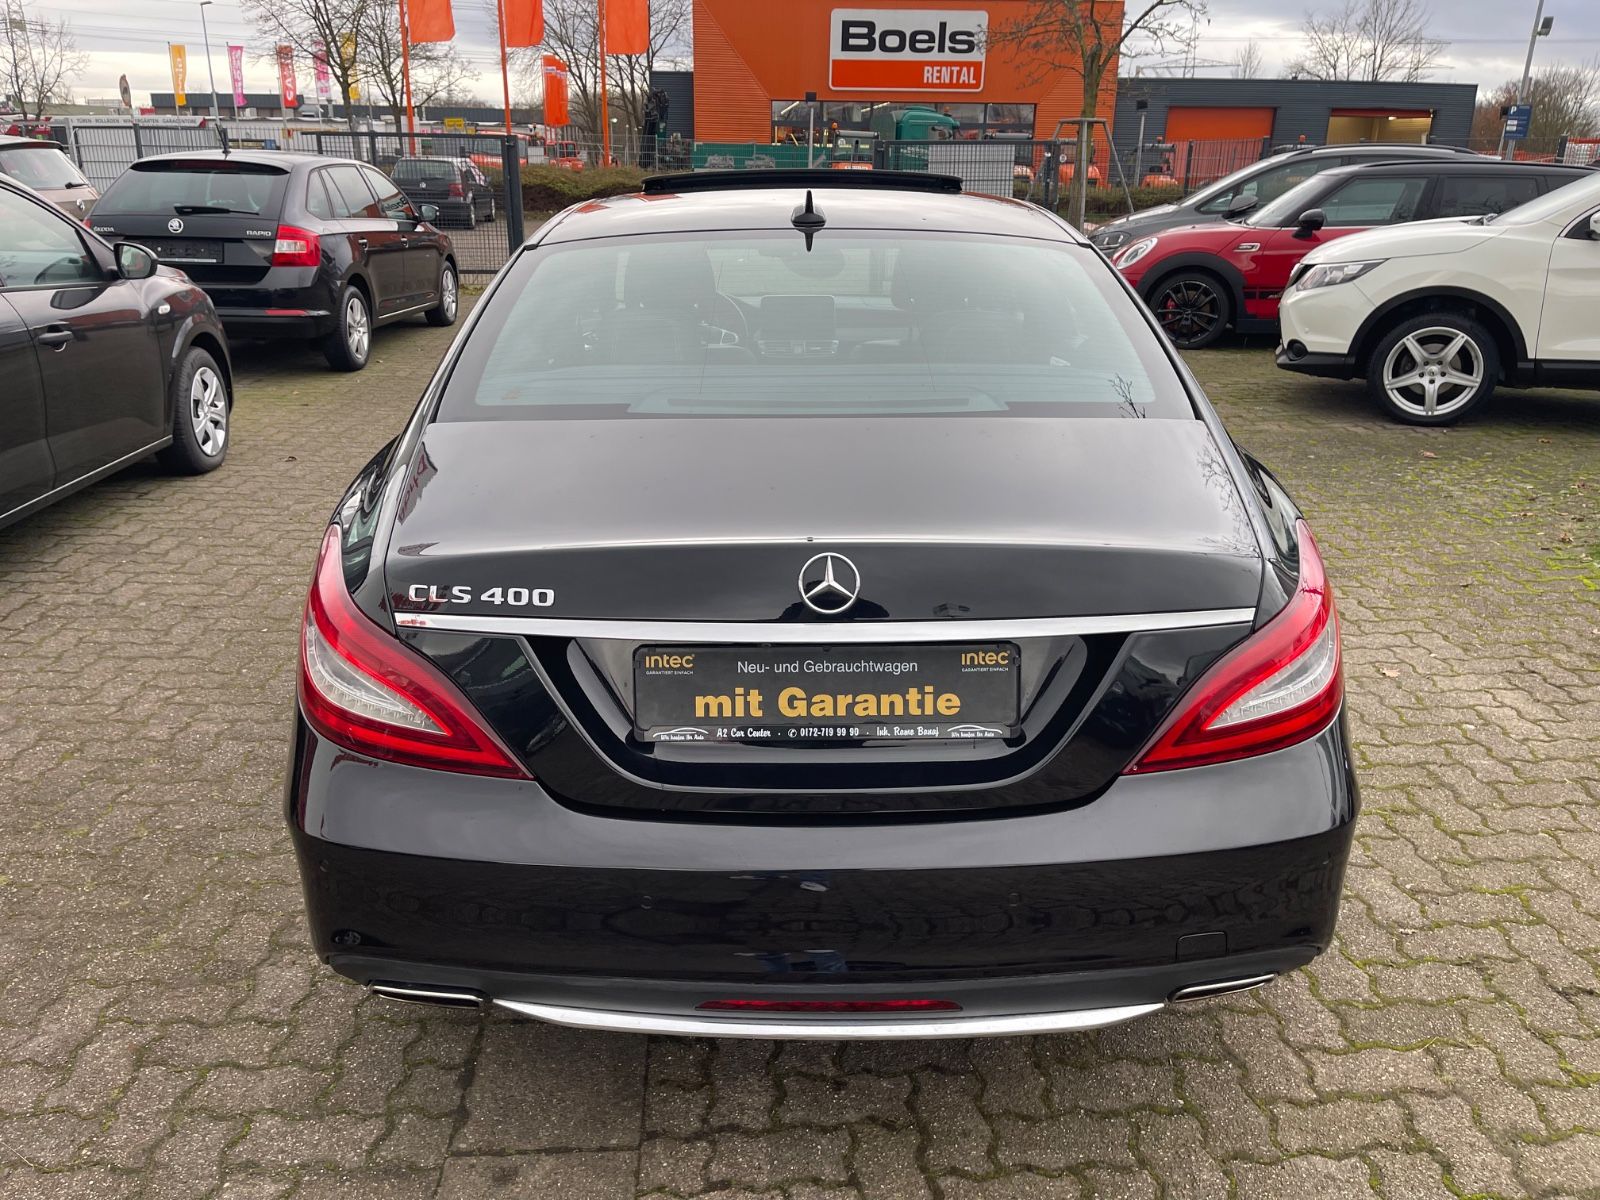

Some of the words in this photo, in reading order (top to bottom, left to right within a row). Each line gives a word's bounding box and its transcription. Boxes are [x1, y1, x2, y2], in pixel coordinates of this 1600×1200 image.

[841, 20, 976, 54] Boels
[923, 66, 976, 84] RENTAL
[408, 584, 472, 604] CLS
[480, 587, 555, 607] 400
[645, 654, 695, 668] intec
[961, 651, 1009, 665] intec
[737, 661, 770, 673] Neu-
[774, 660, 799, 673] und
[803, 659, 918, 675] Gebrauchtwagen
[695, 687, 763, 717] mit
[778, 685, 961, 717] Garantie
[716, 728, 728, 737] A2
[730, 728, 745, 737] Car
[747, 727, 771, 738] Center
[800, 727, 834, 737] 0172-719
[836, 727, 847, 737] 99
[849, 727, 860, 737] 90
[876, 726, 890, 737] Inh.
